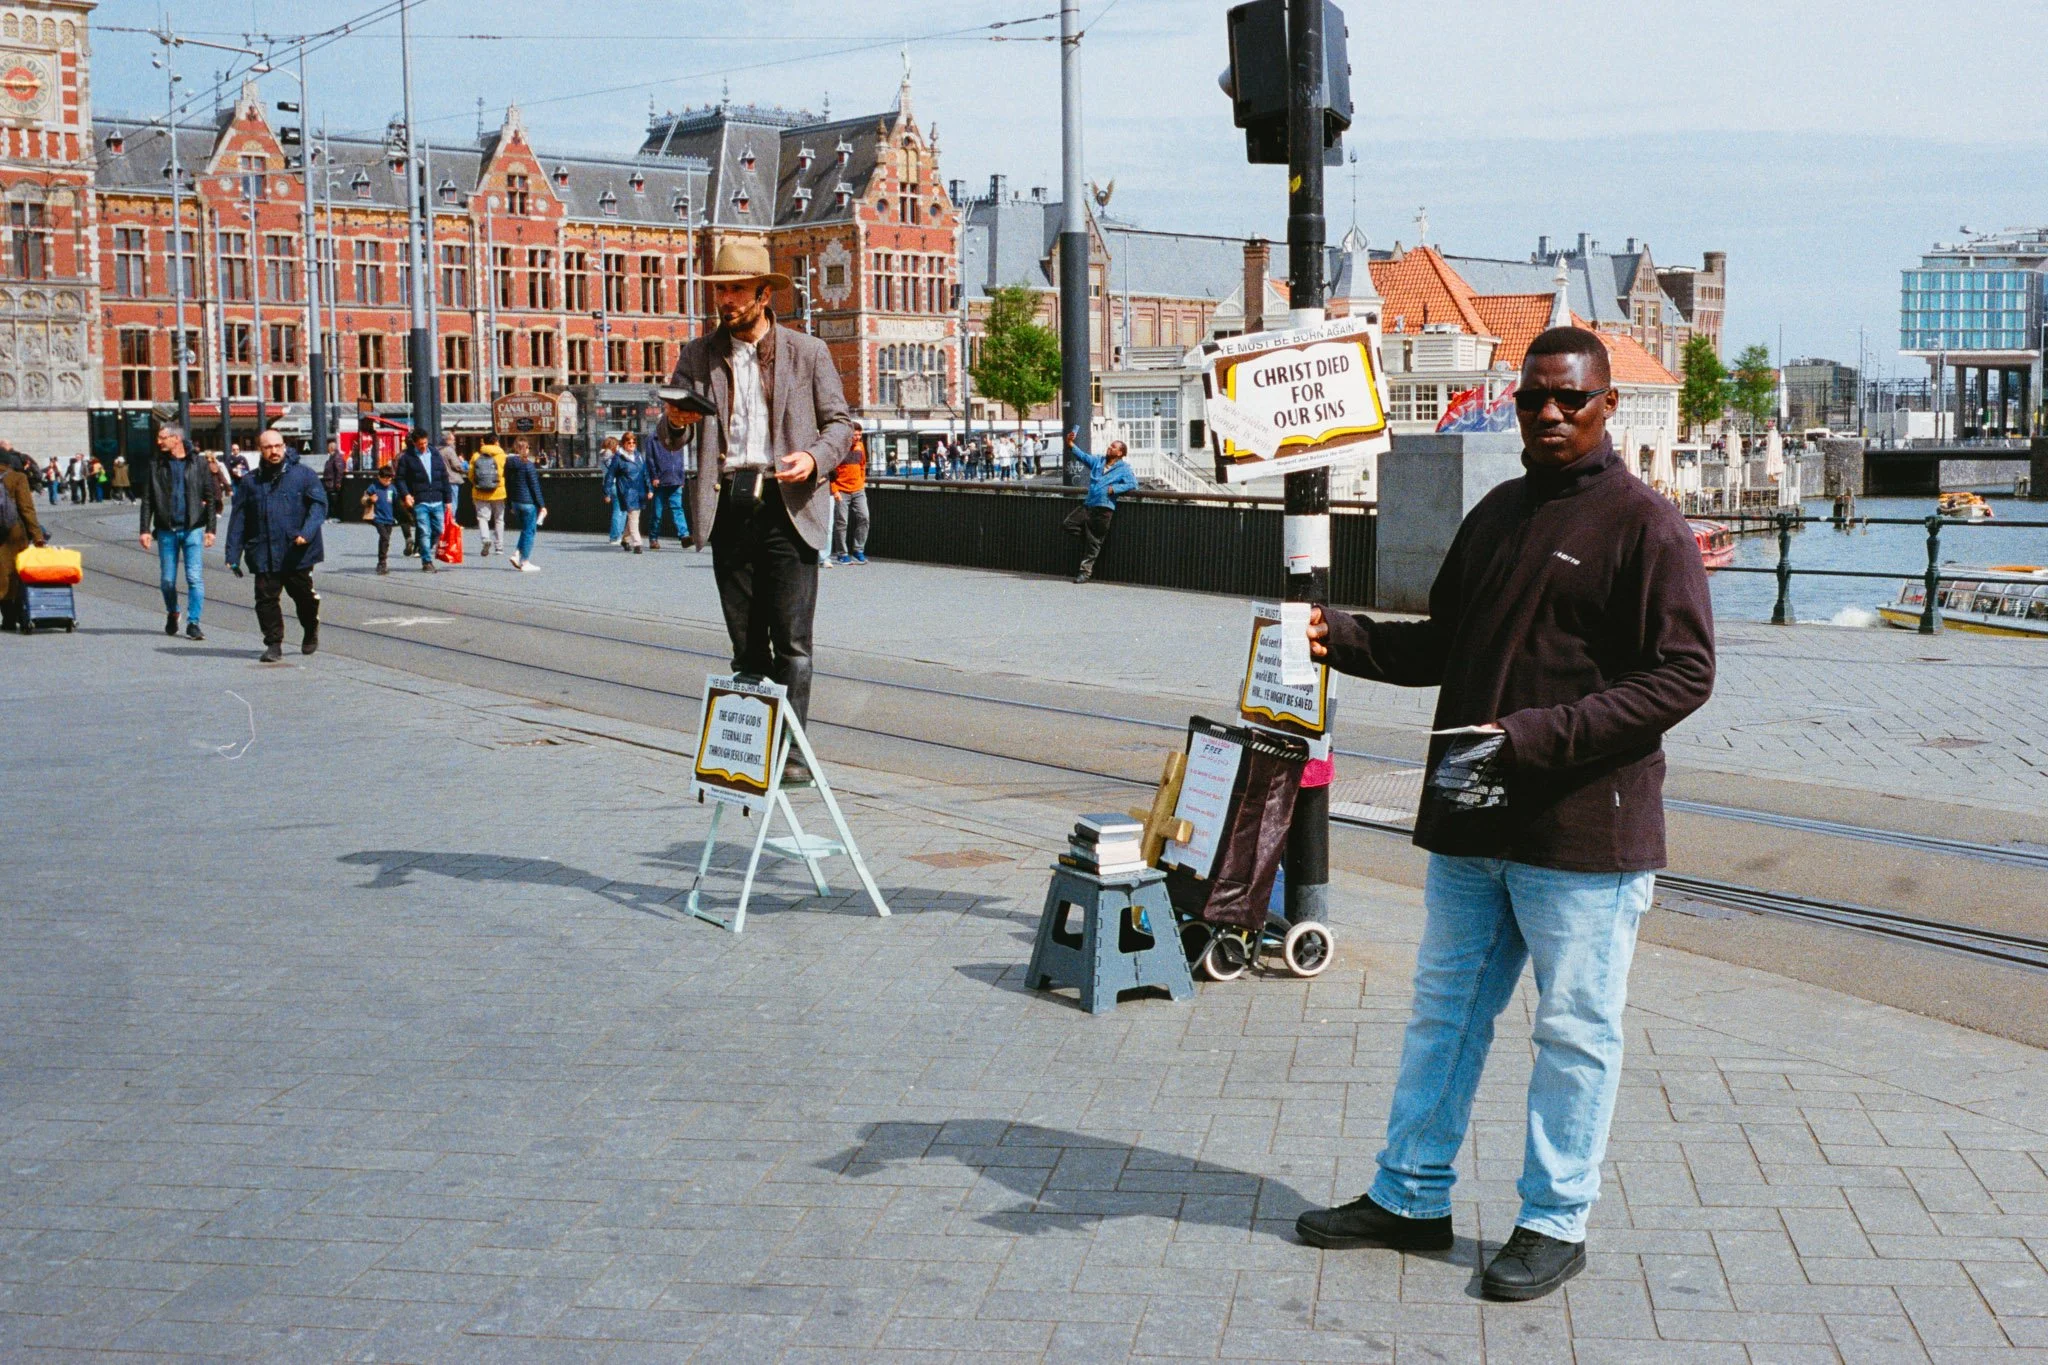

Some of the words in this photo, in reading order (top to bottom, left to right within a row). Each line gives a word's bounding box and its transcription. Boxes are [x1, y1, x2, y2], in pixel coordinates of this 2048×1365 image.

[1253, 361, 1312, 388] CHRIST
[1316, 355, 1349, 377] DIED
[1291, 382, 1325, 404] FOR
[498, 403, 525, 413] CANAL
[528, 401, 553, 413] TOUR
[1274, 407, 1310, 428] OUR
[1314, 399, 1345, 422] SINS
[1203, 744, 1223, 755] FREE
